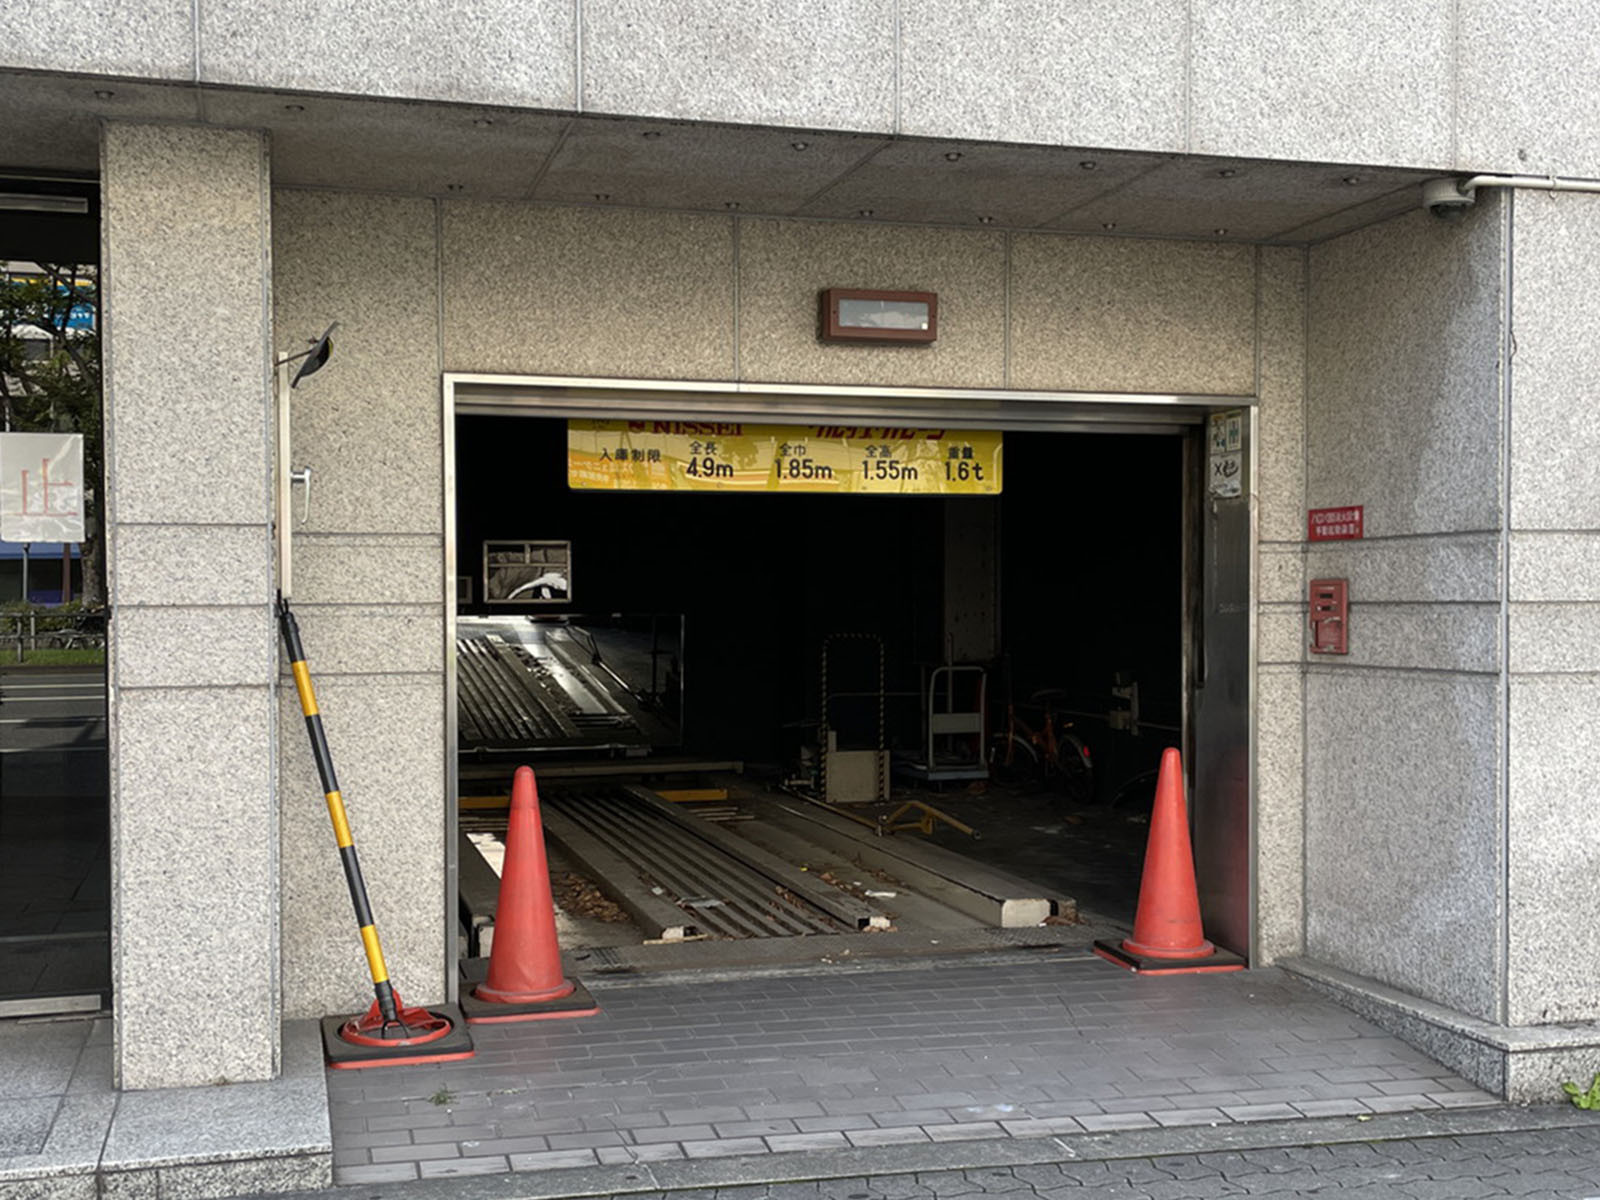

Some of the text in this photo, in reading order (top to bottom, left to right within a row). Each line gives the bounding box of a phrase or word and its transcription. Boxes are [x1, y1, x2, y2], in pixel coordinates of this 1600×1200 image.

[600, 447, 662, 463] 入庫制限
[689, 440, 974, 459] 全長 全巾 全高 重量
[686, 457, 984, 481] 4.9m 1.85m 1.55m 1.6t
